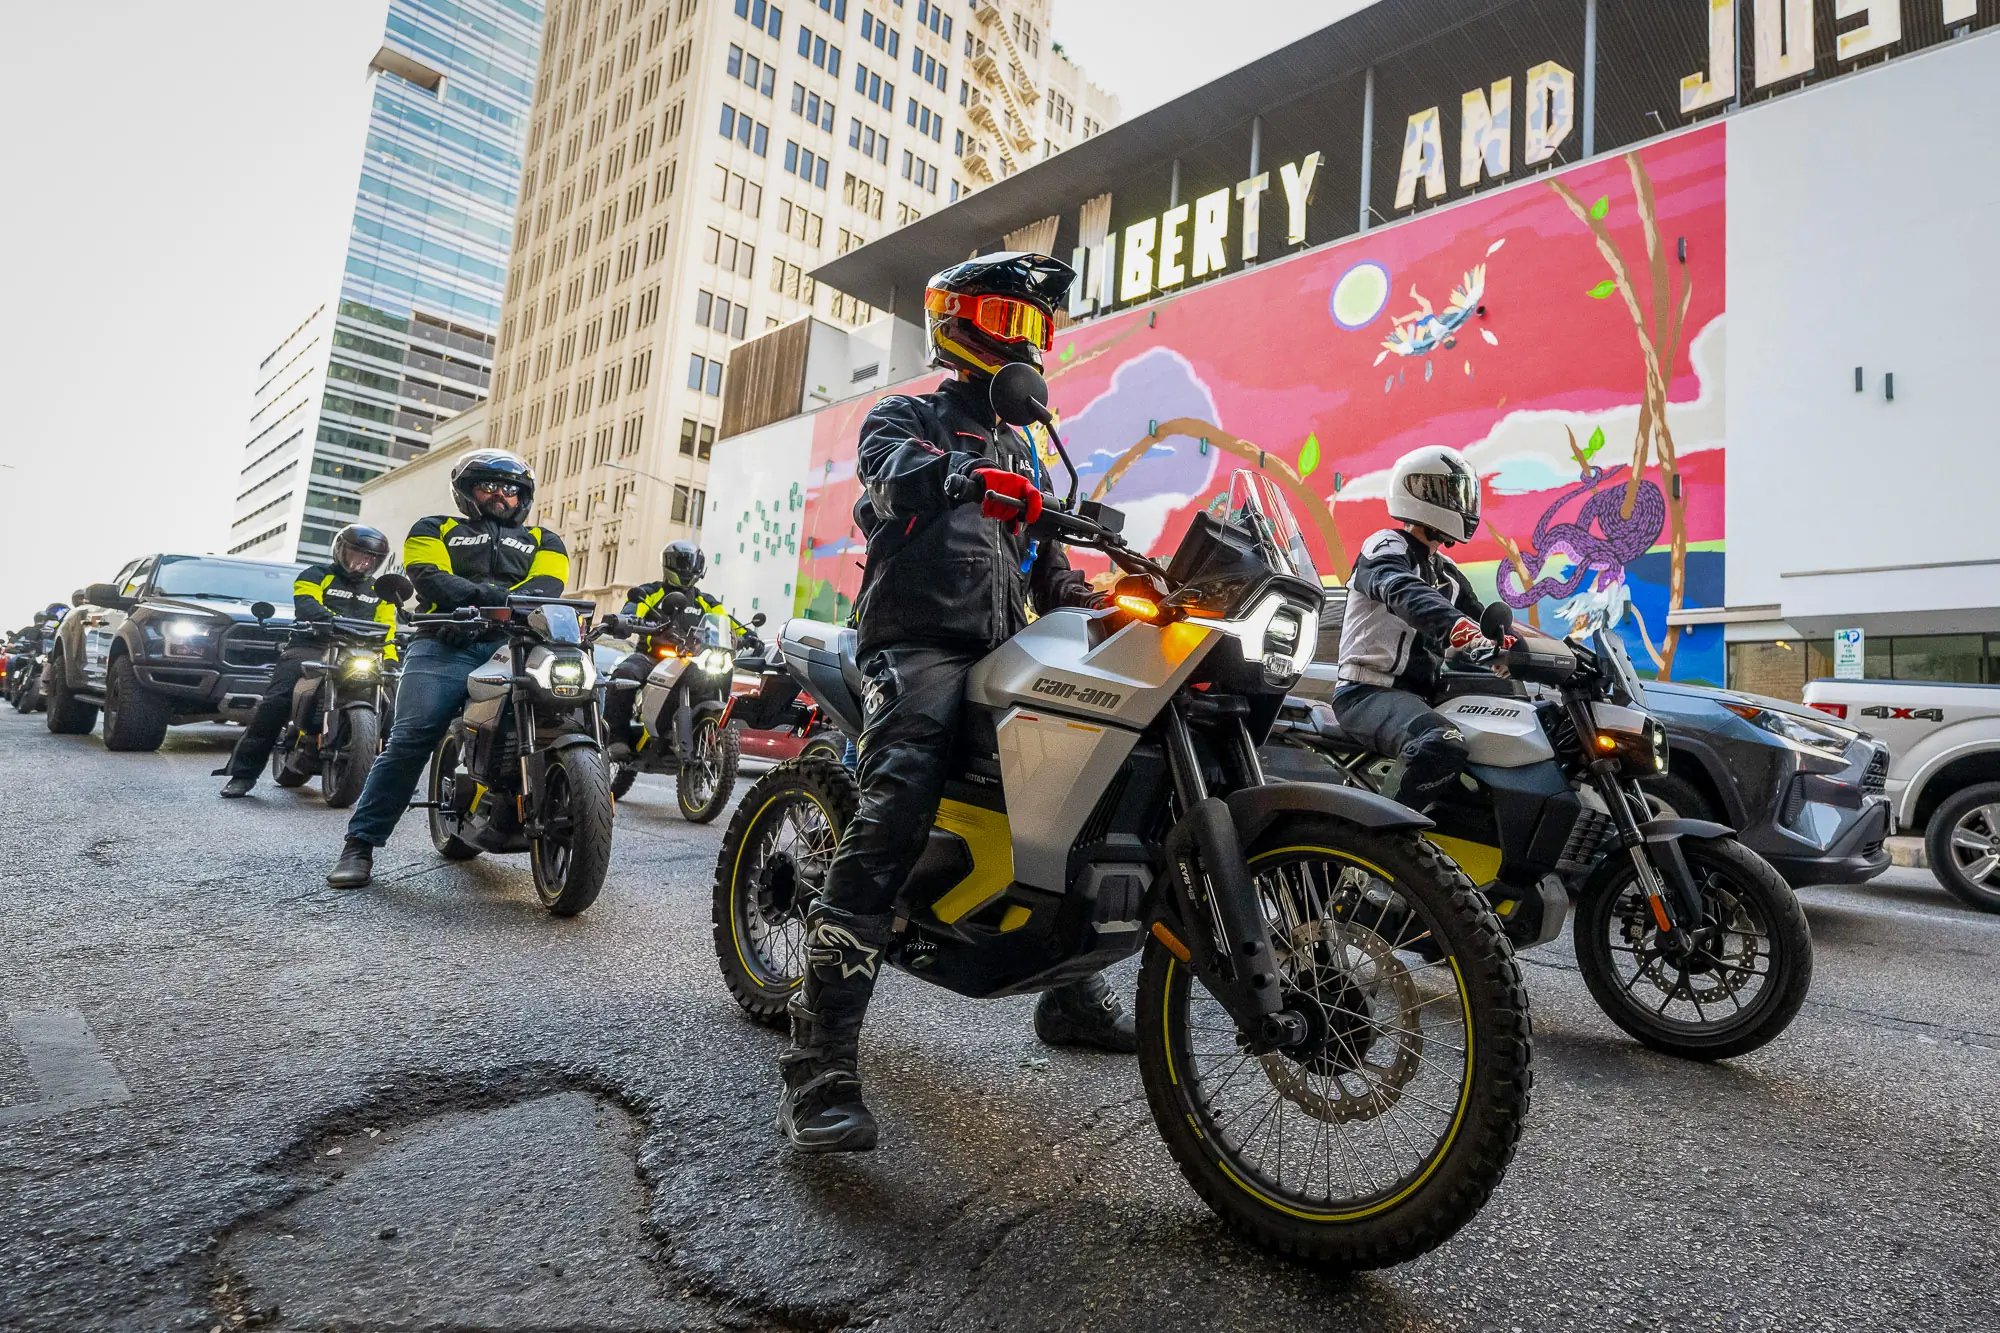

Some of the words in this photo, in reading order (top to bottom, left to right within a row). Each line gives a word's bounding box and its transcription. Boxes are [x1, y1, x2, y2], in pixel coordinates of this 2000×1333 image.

[1068, 151, 1321, 319] LIBERTY
[1394, 60, 1574, 210] AND
[1032, 678, 1121, 709] can-am
[1457, 704, 1520, 718] can-am
